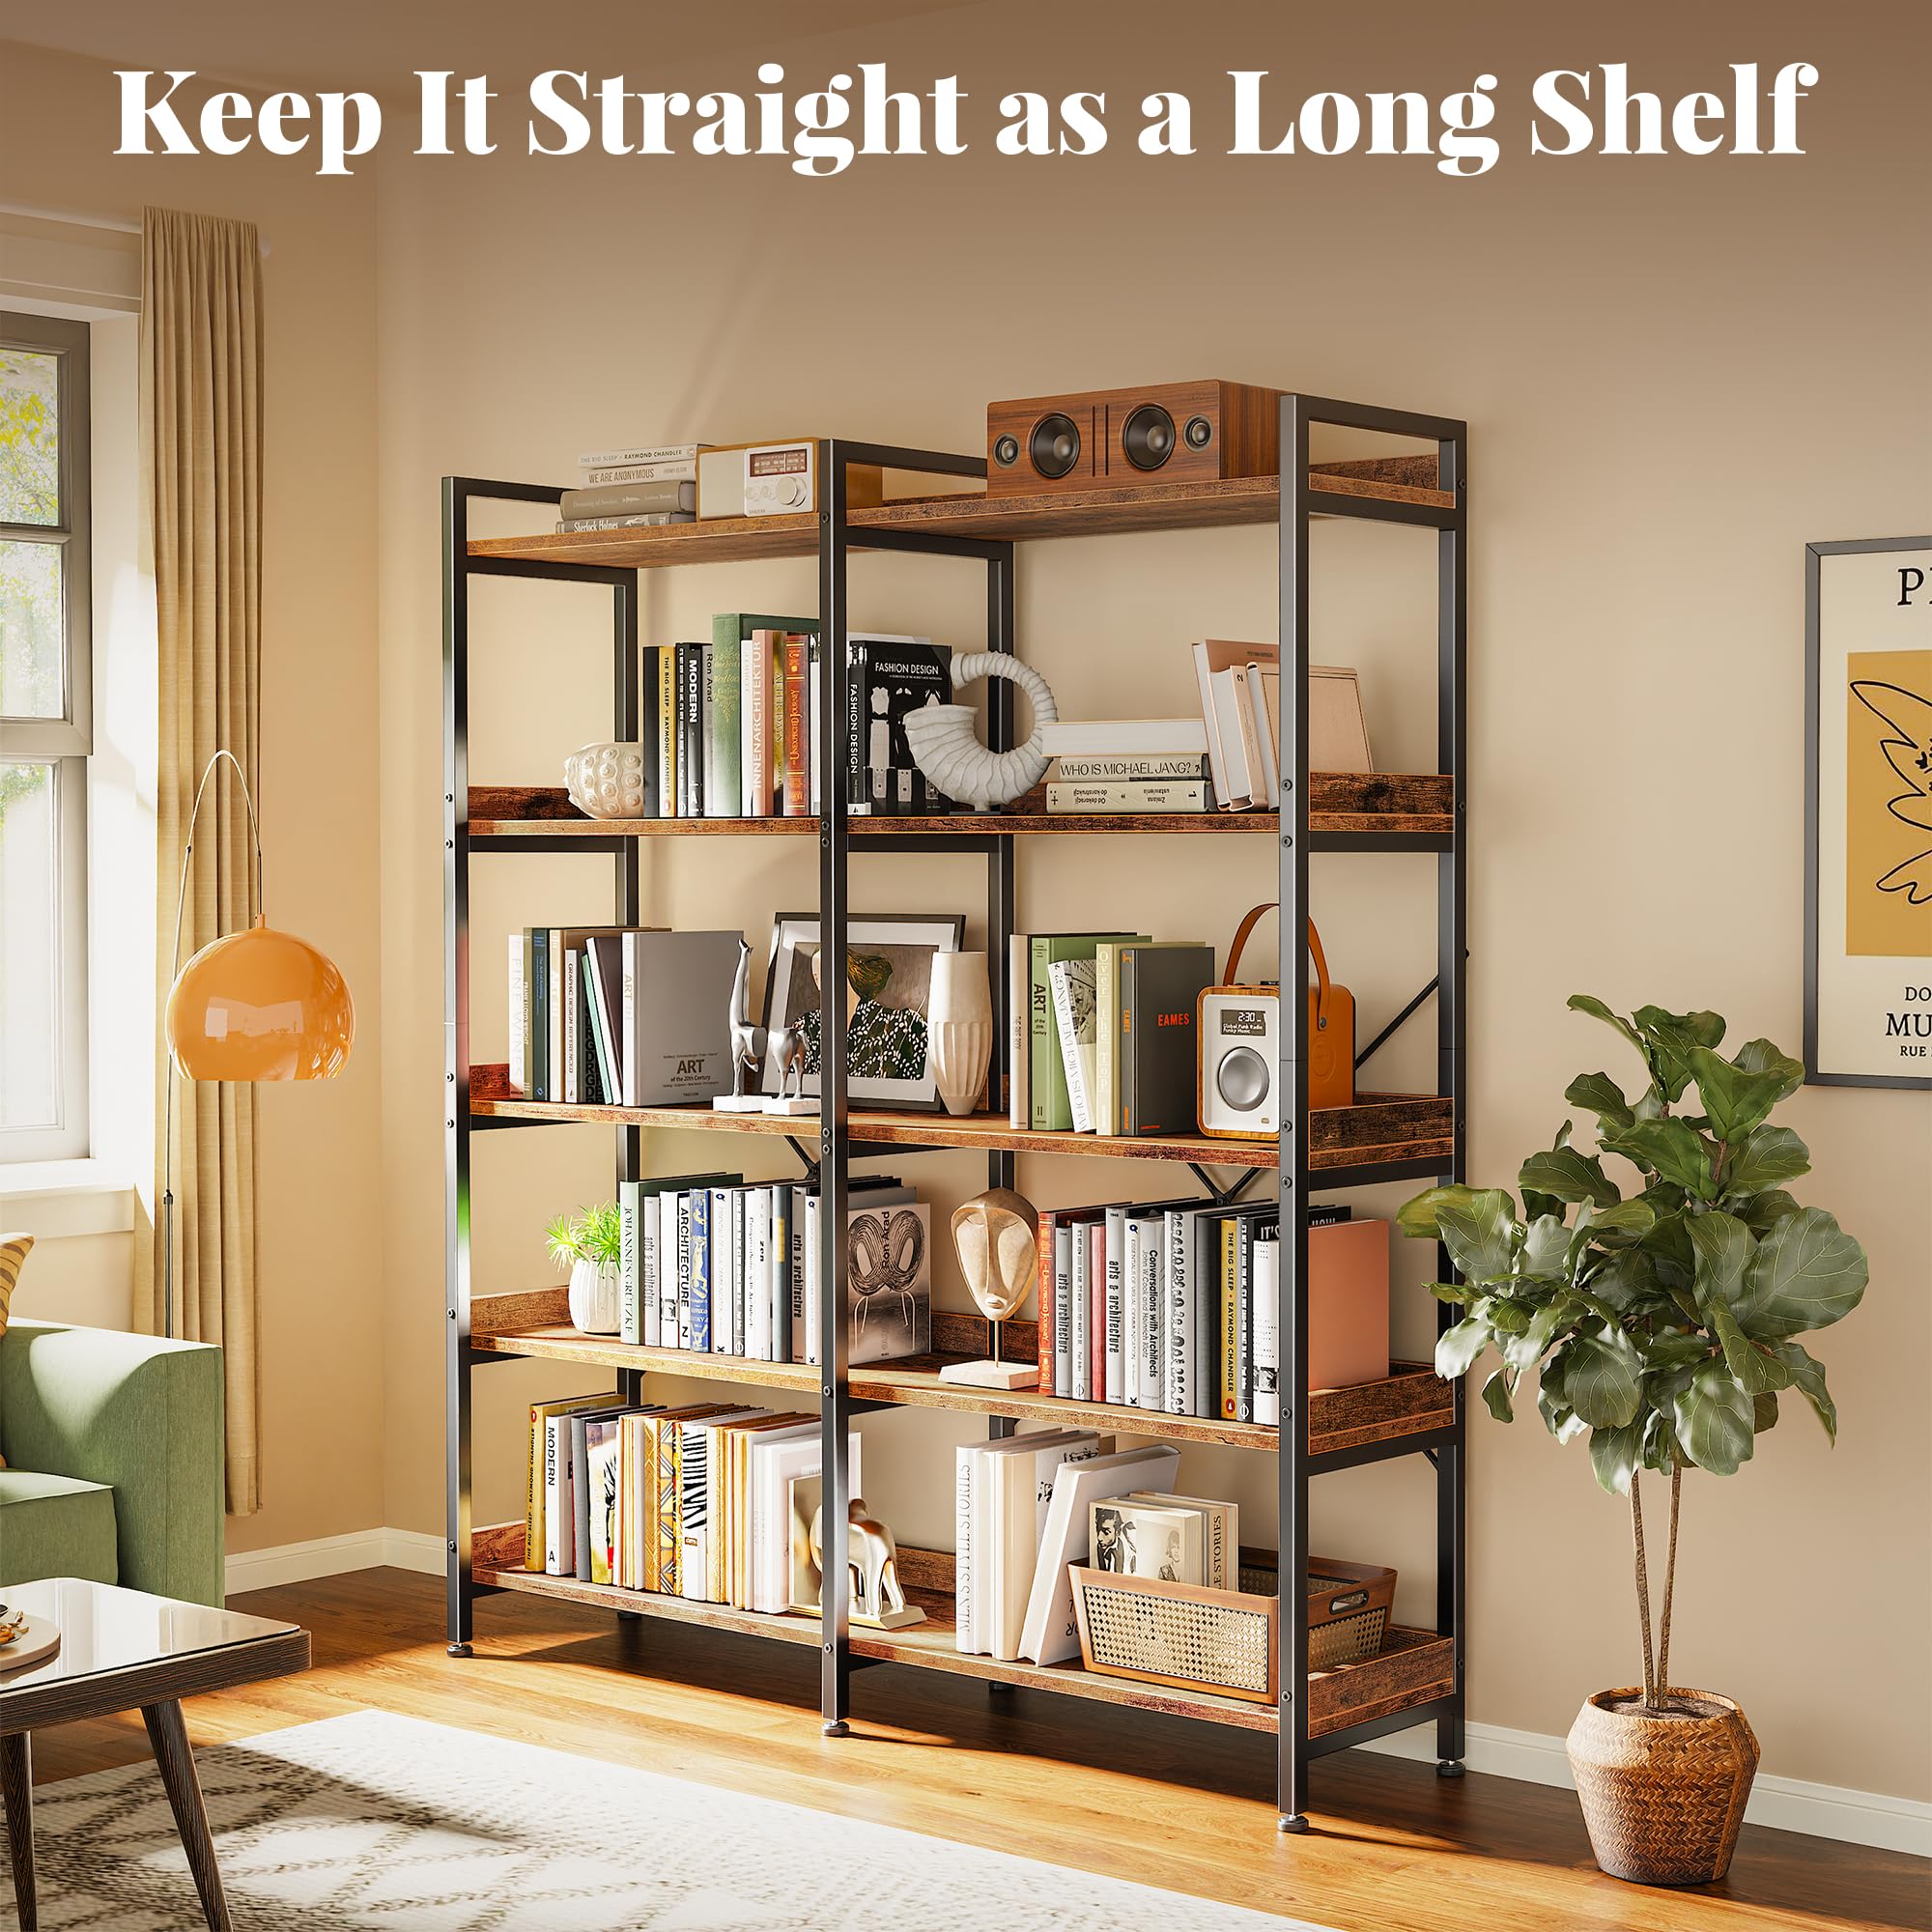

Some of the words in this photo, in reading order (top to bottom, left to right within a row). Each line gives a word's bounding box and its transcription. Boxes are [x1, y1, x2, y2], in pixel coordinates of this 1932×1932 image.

[653, 449, 682, 457] CHANDLER
[589, 473, 599, 484] WE
[600, 472, 612, 483] ARE
[614, 468, 655, 482] ANONYMOUS
[574, 522, 597, 532] Sherlock
[598, 520, 619, 530] Holmes
[1897, 567, 1932, 606] P
[875, 662, 909, 673] FASHION
[910, 664, 939, 675] DESIGN
[1236, 674, 1244, 682] 2
[689, 659, 697, 723] MODERN
[753, 641, 761, 788] INNENARCHITEKTUR
[1060, 764, 1089, 776] WHO
[1091, 764, 1101, 775] IS
[1103, 762, 1153, 775] MICHAEL
[1154, 762, 1191, 774] JANG?
[1099, 951, 1108, 996] Over
[1034, 983, 1046, 1013] ART
[1054, 975, 1068, 1017] JANG?
[1099, 1009, 1109, 1042] the
[1158, 1013, 1190, 1027] EAMES
[1238, 1012, 1255, 1022] 2:30
[1062, 1022, 1078, 1077] MICHAEL
[1900, 1045, 1926, 1057] RUE
[677, 1059, 704, 1074] ART
[1099, 1052, 1108, 1091] Top
[1071, 1080, 1080, 1094] IS
[1074, 1097, 1088, 1130] WHO
[625, 1207, 633, 1273] JOHANNES
[881, 1211, 890, 1240] Arad
[645, 1237, 653, 1251] arts
[681, 1208, 689, 1307] ARCHITECTURE
[794, 1234, 802, 1252] arts
[644, 1263, 655, 1307] architecture
[1059, 1273, 1068, 1290] arts
[1109, 1261, 1120, 1279] arts
[1149, 1250, 1158, 1312] Conversations
[793, 1265, 804, 1318] architecture
[682, 1326, 688, 1337] Z
[1058, 1304, 1069, 1353] architecture
[1109, 1295, 1122, 1353] architecture
[1149, 1313, 1158, 1332] with
[1149, 1334, 1159, 1378] Architects
[959, 1464, 970, 1529] STORIES
[549, 1551, 555, 1563] A
[959, 1534, 970, 1582] STYLE
[959, 1585, 970, 1633] MEN'S
